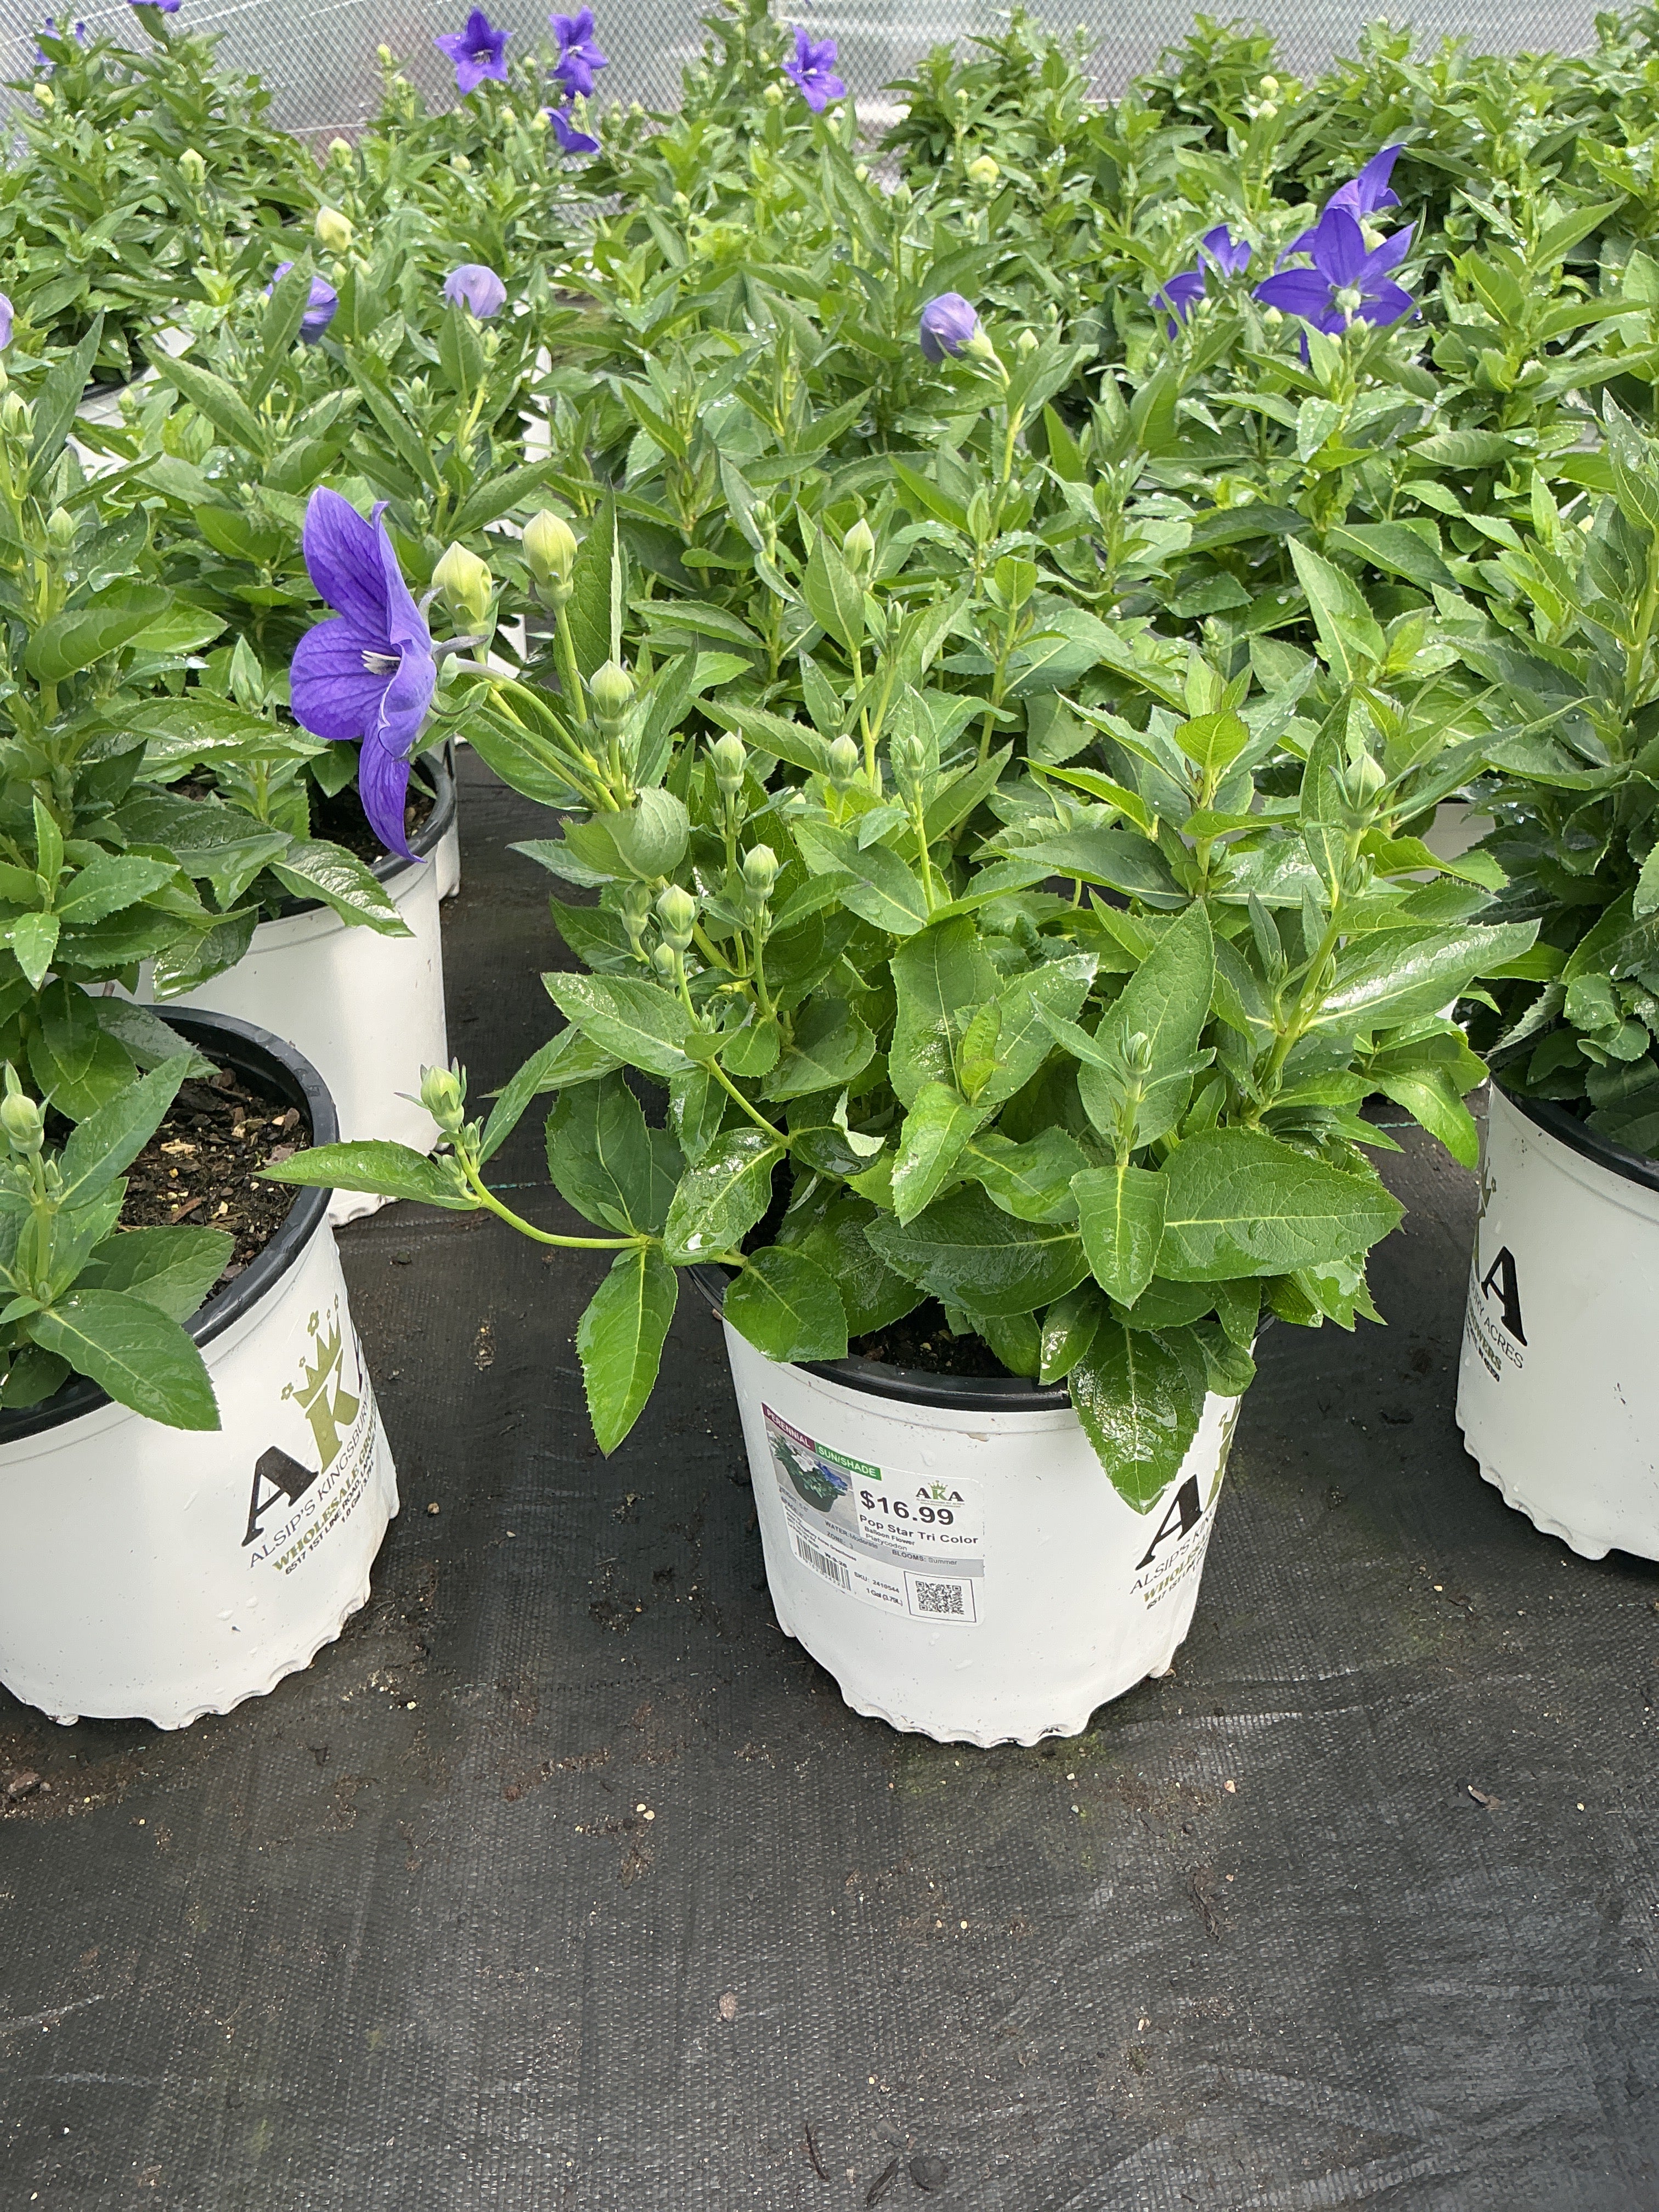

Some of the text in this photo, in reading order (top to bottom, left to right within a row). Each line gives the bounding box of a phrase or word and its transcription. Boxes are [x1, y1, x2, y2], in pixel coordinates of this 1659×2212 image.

[1484, 1317, 1523, 1369] ACRES
[767, 1409, 877, 1477] PERENNIAL SUN/SHADE
[860, 1490, 954, 1525] $16.99
[916, 1485, 964, 1502] AKA
[250, 1499, 316, 1568] ALSIP'S
[272, 1464, 359, 1571] WHOLESALE
[860, 1514, 979, 1544] Pop Star Tri Color
[864, 1526, 915, 1546] Balloon Flower
[285, 1550, 306, 1575] 6517
[309, 1531, 323, 1551] 1ST
[325, 1509, 342, 1534] LINE
[866, 1533, 907, 1551] Platycodon
[891, 1549, 958, 1565] BLOOMS: Summer
[1130, 1539, 1190, 1595] ALSIP'S
